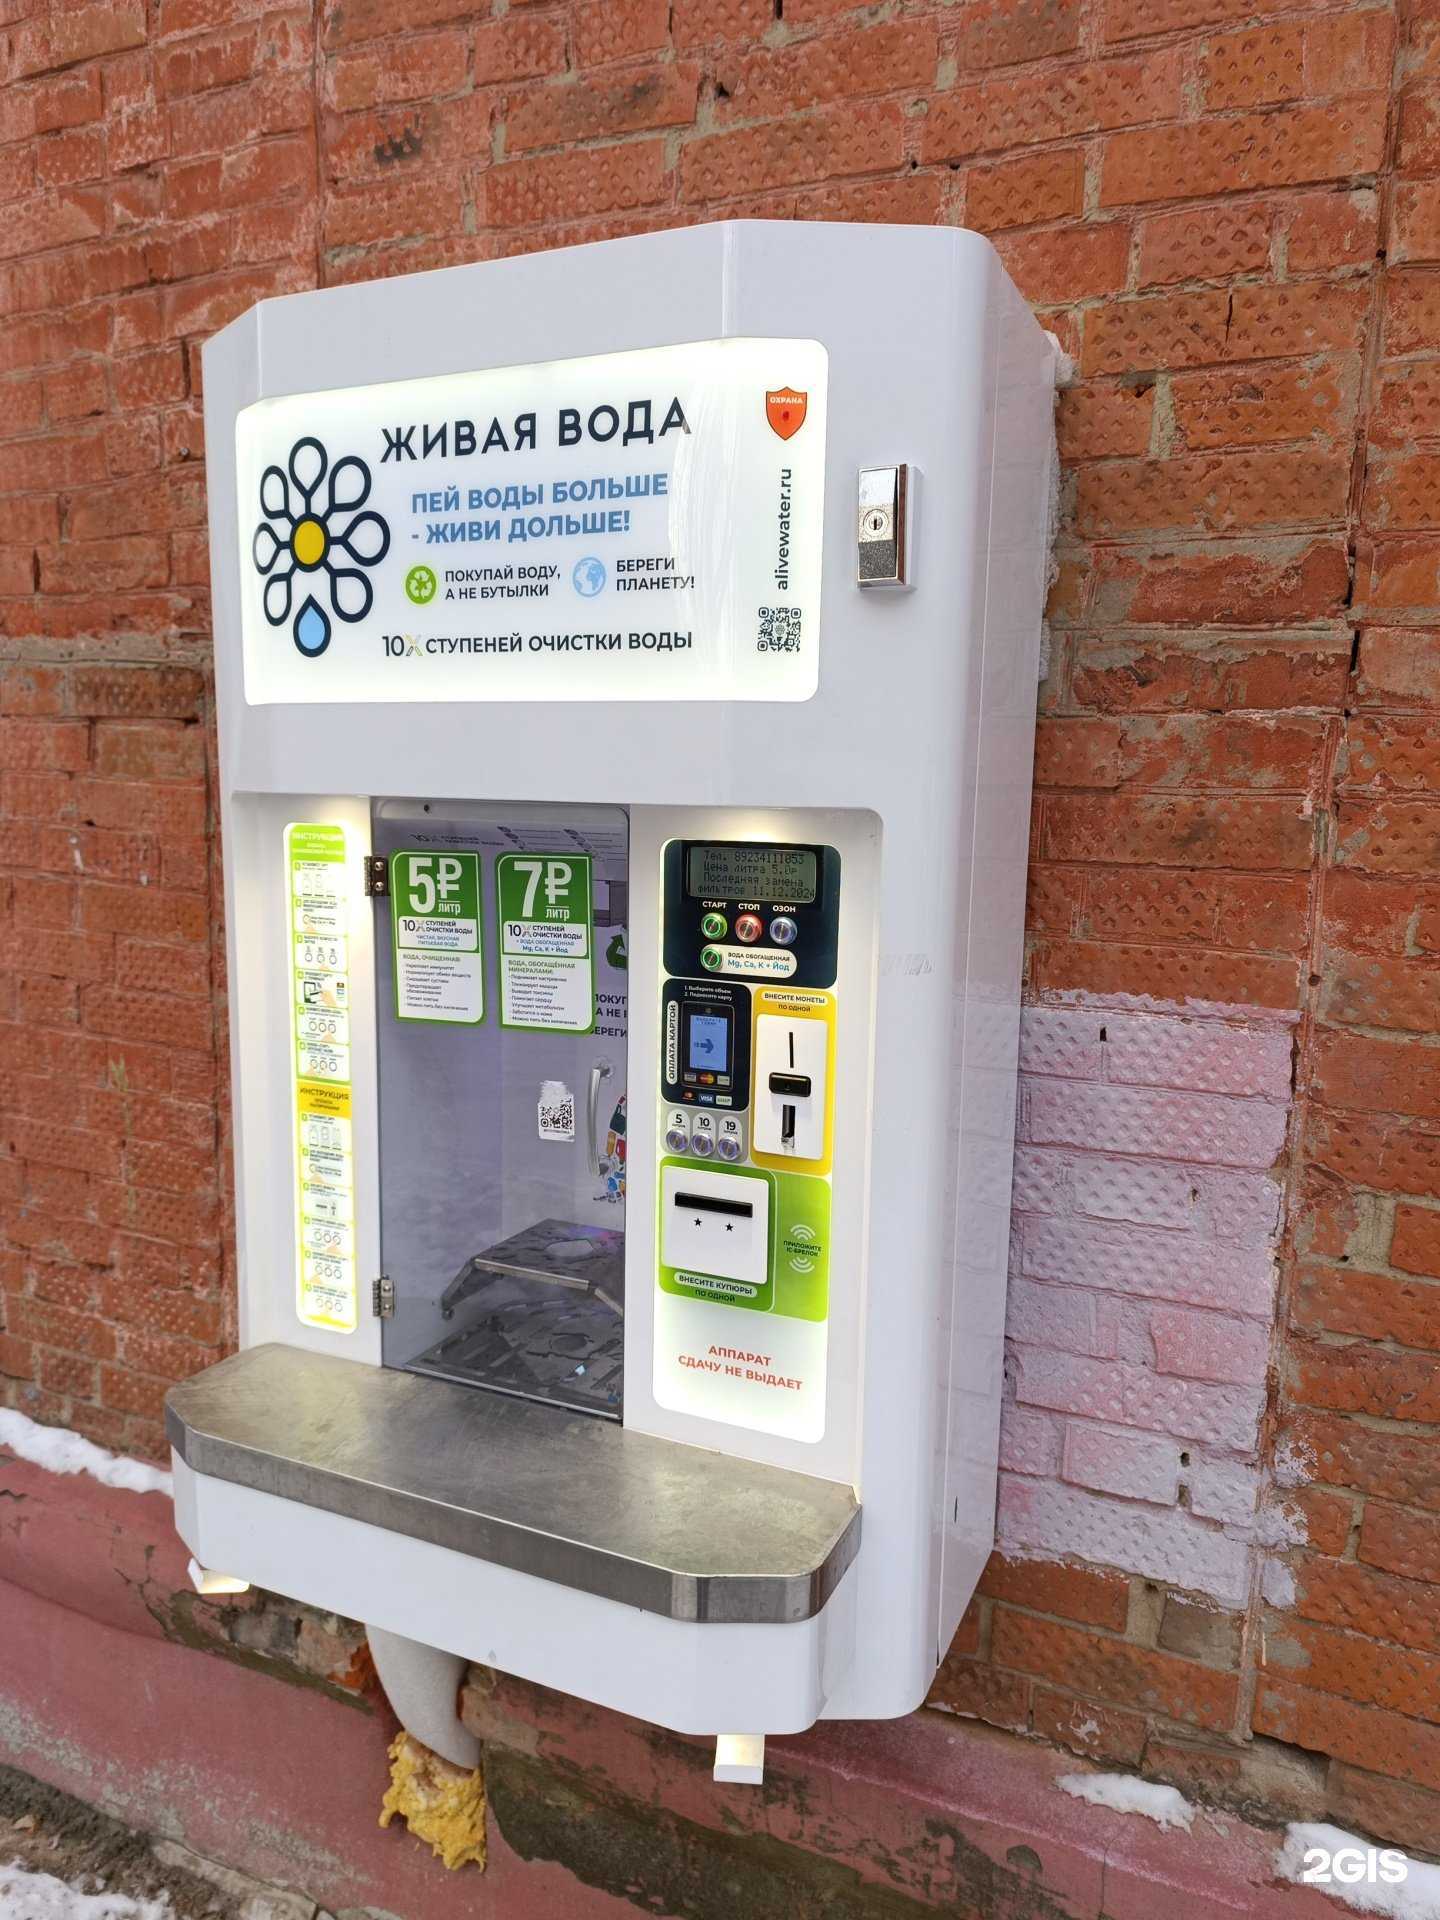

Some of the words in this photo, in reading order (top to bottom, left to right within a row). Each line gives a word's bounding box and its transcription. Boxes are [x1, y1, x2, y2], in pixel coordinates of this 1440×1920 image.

[768, 396, 804, 405] ОХРАНА
[380, 412, 537, 464] ЖИВАЯ
[558, 396, 692, 447] ВОДА
[411, 485, 460, 514] ПЕЙ
[468, 482, 544, 512] ВОДЫ
[552, 472, 668, 504] БОЛЬШЕ
[426, 519, 501, 544] ЖИВИ
[508, 509, 631, 543] ДОЛЬШЕ!
[774, 467, 792, 591] alivewater.ru
[616, 557, 675, 573] БЕРЕГИ
[445, 564, 514, 583] ПОКУПАЙ
[518, 564, 562, 581] ВОДУ,
[616, 574, 696, 592] ПЛАНЕТУ!
[445, 588, 455, 600] А
[459, 587, 477, 600] НЕ
[480, 583, 549, 600] БУТЫЛКИ
[425, 632, 523, 655] СТУПЕНЕЙ
[527, 633, 623, 653] ОЧИСТКИ
[628, 630, 692, 652] ВОДЫ
[702, 901, 727, 910] СТАРТ
[738, 903, 761, 912] СТОП
[772, 905, 797, 913] ОЗОН
[425, 920, 457, 928] СТУПЕНЕЙ
[425, 926, 454, 934] ОЧИСТКИ
[454, 928, 473, 936] ВОДЫ
[532, 931, 562, 939] ОЧИСТКИ
[562, 933, 583, 941] ВОДЫ
[727, 951, 745, 959] ВОДА
[772, 959, 790, 972] Йод
[763, 992, 795, 1002] ВНЕСИТЕ
[795, 994, 826, 1004] МОНЕТЫ
[788, 1004, 811, 1013] ОДНОЙ
[668, 1003, 676, 1041] КАРТОЙ
[592, 1026, 627, 1038] ЕРЕГИ
[668, 1041, 676, 1080] ОПЛАТА
[675, 1114, 683, 1124] 5
[699, 1117, 711, 1127] 10
[725, 1120, 737, 1131] 19
[679, 1274, 716, 1289] ВНЕСИТЕ
[716, 1281, 753, 1296] КУПЮРЫ
[695, 1288, 707, 1298] ПО
[707, 1290, 736, 1304] ОДНОЙ
[708, 1344, 772, 1368] АППАРАТ
[678, 1354, 722, 1375] СДАЧУ
[725, 1364, 742, 1378] НЕ
[746, 1368, 803, 1392] ВЫДАЕТ
